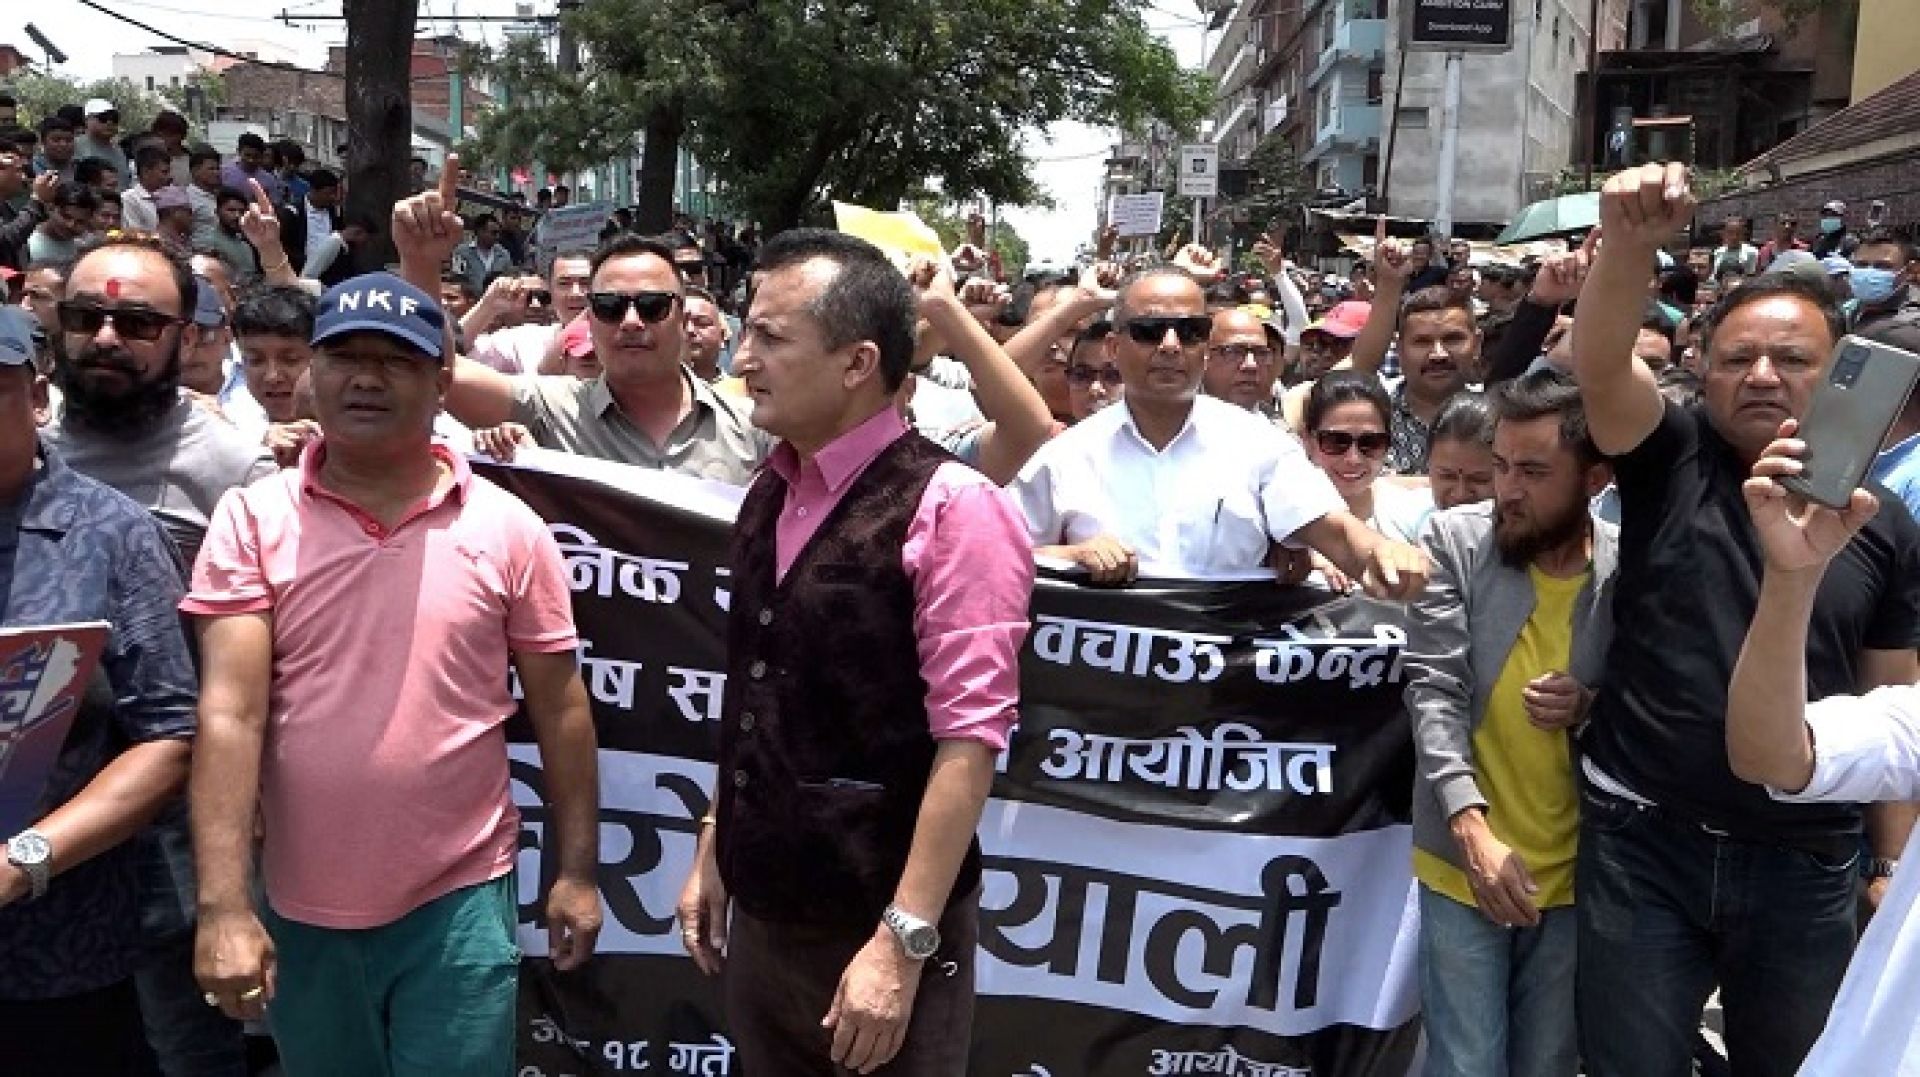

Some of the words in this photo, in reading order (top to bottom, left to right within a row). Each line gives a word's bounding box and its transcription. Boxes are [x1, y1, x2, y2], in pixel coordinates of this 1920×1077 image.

[338, 287, 420, 316] NKF
[548, 523, 689, 604] निक
[1253, 624, 1408, 689] केन्द्री
[1040, 722, 1337, 795] आयोजित
[977, 854, 1342, 1011] याली
[602, 1040, 650, 1070] १८
[668, 1032, 736, 1077] गते
